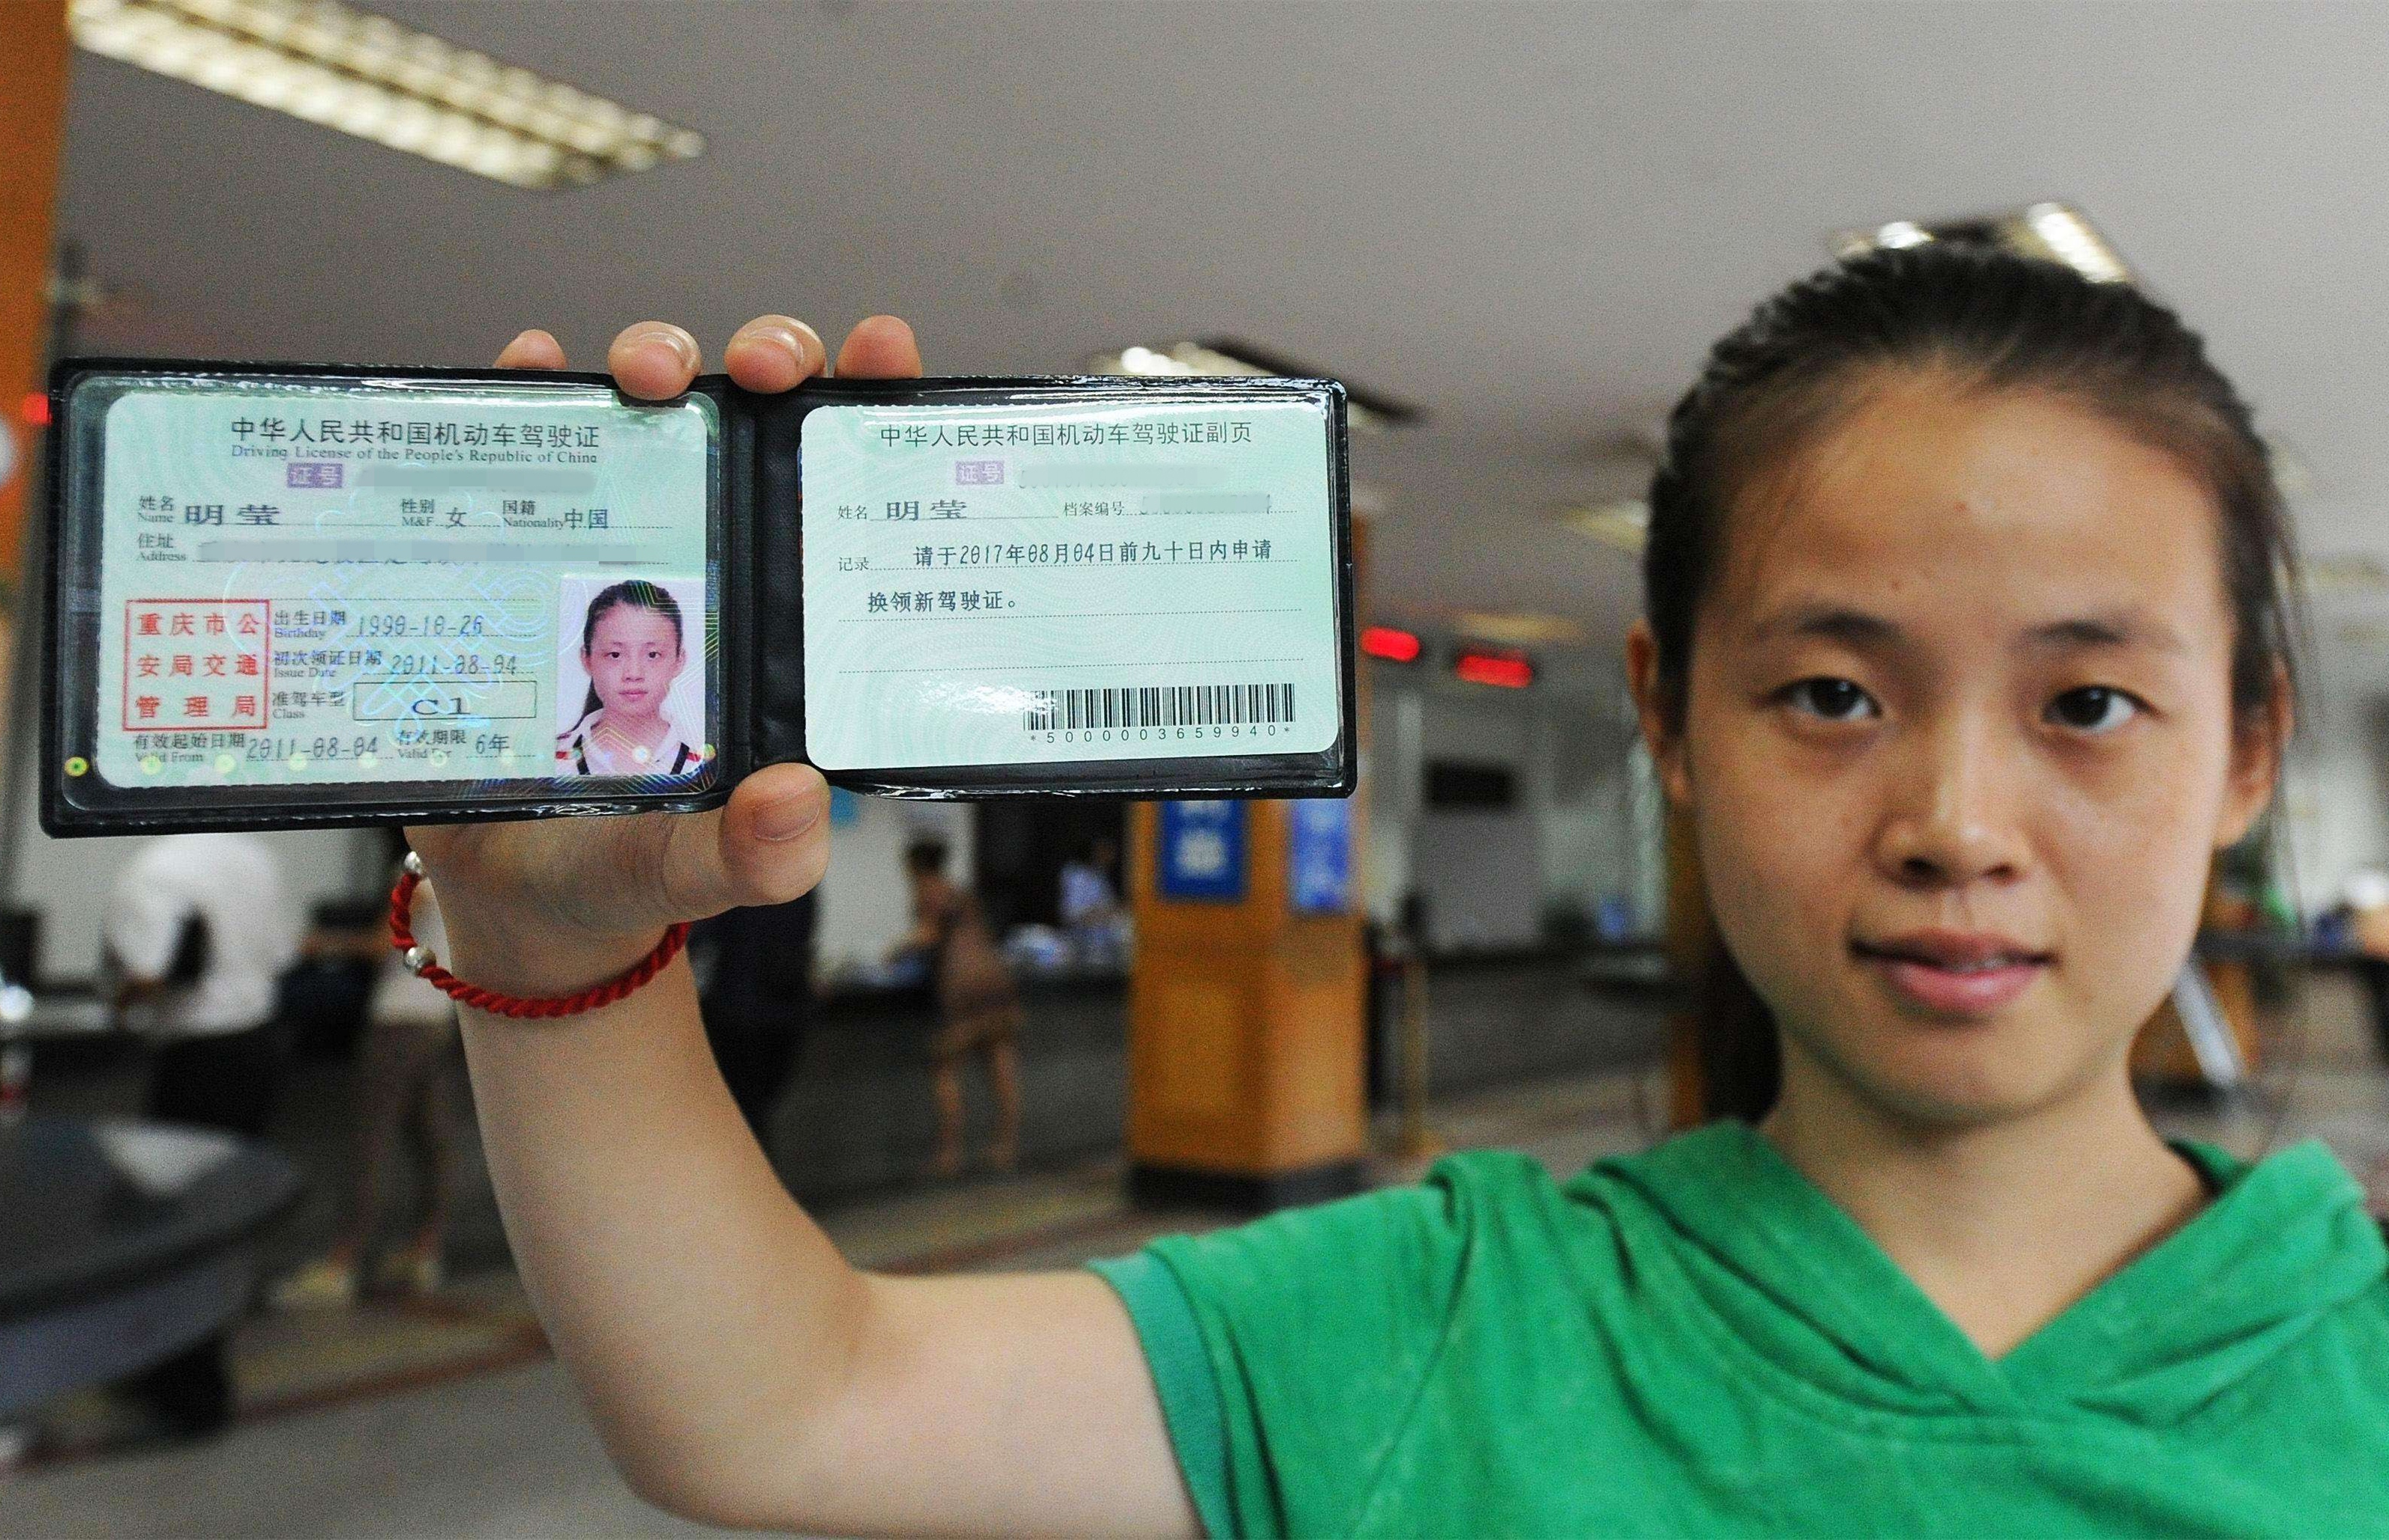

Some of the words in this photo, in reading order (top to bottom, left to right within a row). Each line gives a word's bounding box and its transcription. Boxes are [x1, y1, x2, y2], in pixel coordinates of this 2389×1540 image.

[231, 417, 599, 448] 中华人民共和国机动车驾驶证
[881, 421, 1252, 447] 中华人民共和国机动车驾驶证副页
[231, 444, 287, 460] Driving
[295, 446, 353, 459] License
[357, 447, 373, 459] of
[377, 448, 399, 460] the
[405, 449, 463, 463] People's
[469, 450, 533, 464] Republic
[537, 450, 552, 462] of
[558, 451, 597, 464] China
[290, 464, 341, 486] 证号
[959, 462, 1002, 483] 证号
[139, 495, 174, 511] 姓名
[402, 498, 435, 514] 性别
[446, 507, 467, 528] 女
[837, 504, 868, 520] 姓名
[1064, 501, 1125, 516] 档案编号
[138, 513, 174, 523] Name
[502, 500, 535, 516] 国籍
[565, 508, 608, 530] 中国
[503, 517, 564, 530] Nationality
[138, 533, 174, 549] 住址
[137, 551, 186, 561] Address
[838, 557, 870, 572] 记录
[913, 539, 1272, 567] 请于2017年08月04日前九十日内申请
[867, 590, 1016, 614] 换领新驾驶证。
[138, 612, 260, 636] 重庆市公
[274, 610, 347, 627] 出生日期
[137, 654, 260, 677] 安局交通
[135, 695, 256, 718] 管理局
[272, 708, 305, 719] Class
[412, 697, 471, 715] C1
[135, 733, 245, 749] 有效起始日期
[246, 736, 378, 760] 2011-08-04
[475, 733, 510, 755] 6年
[172, 751, 204, 763] From
